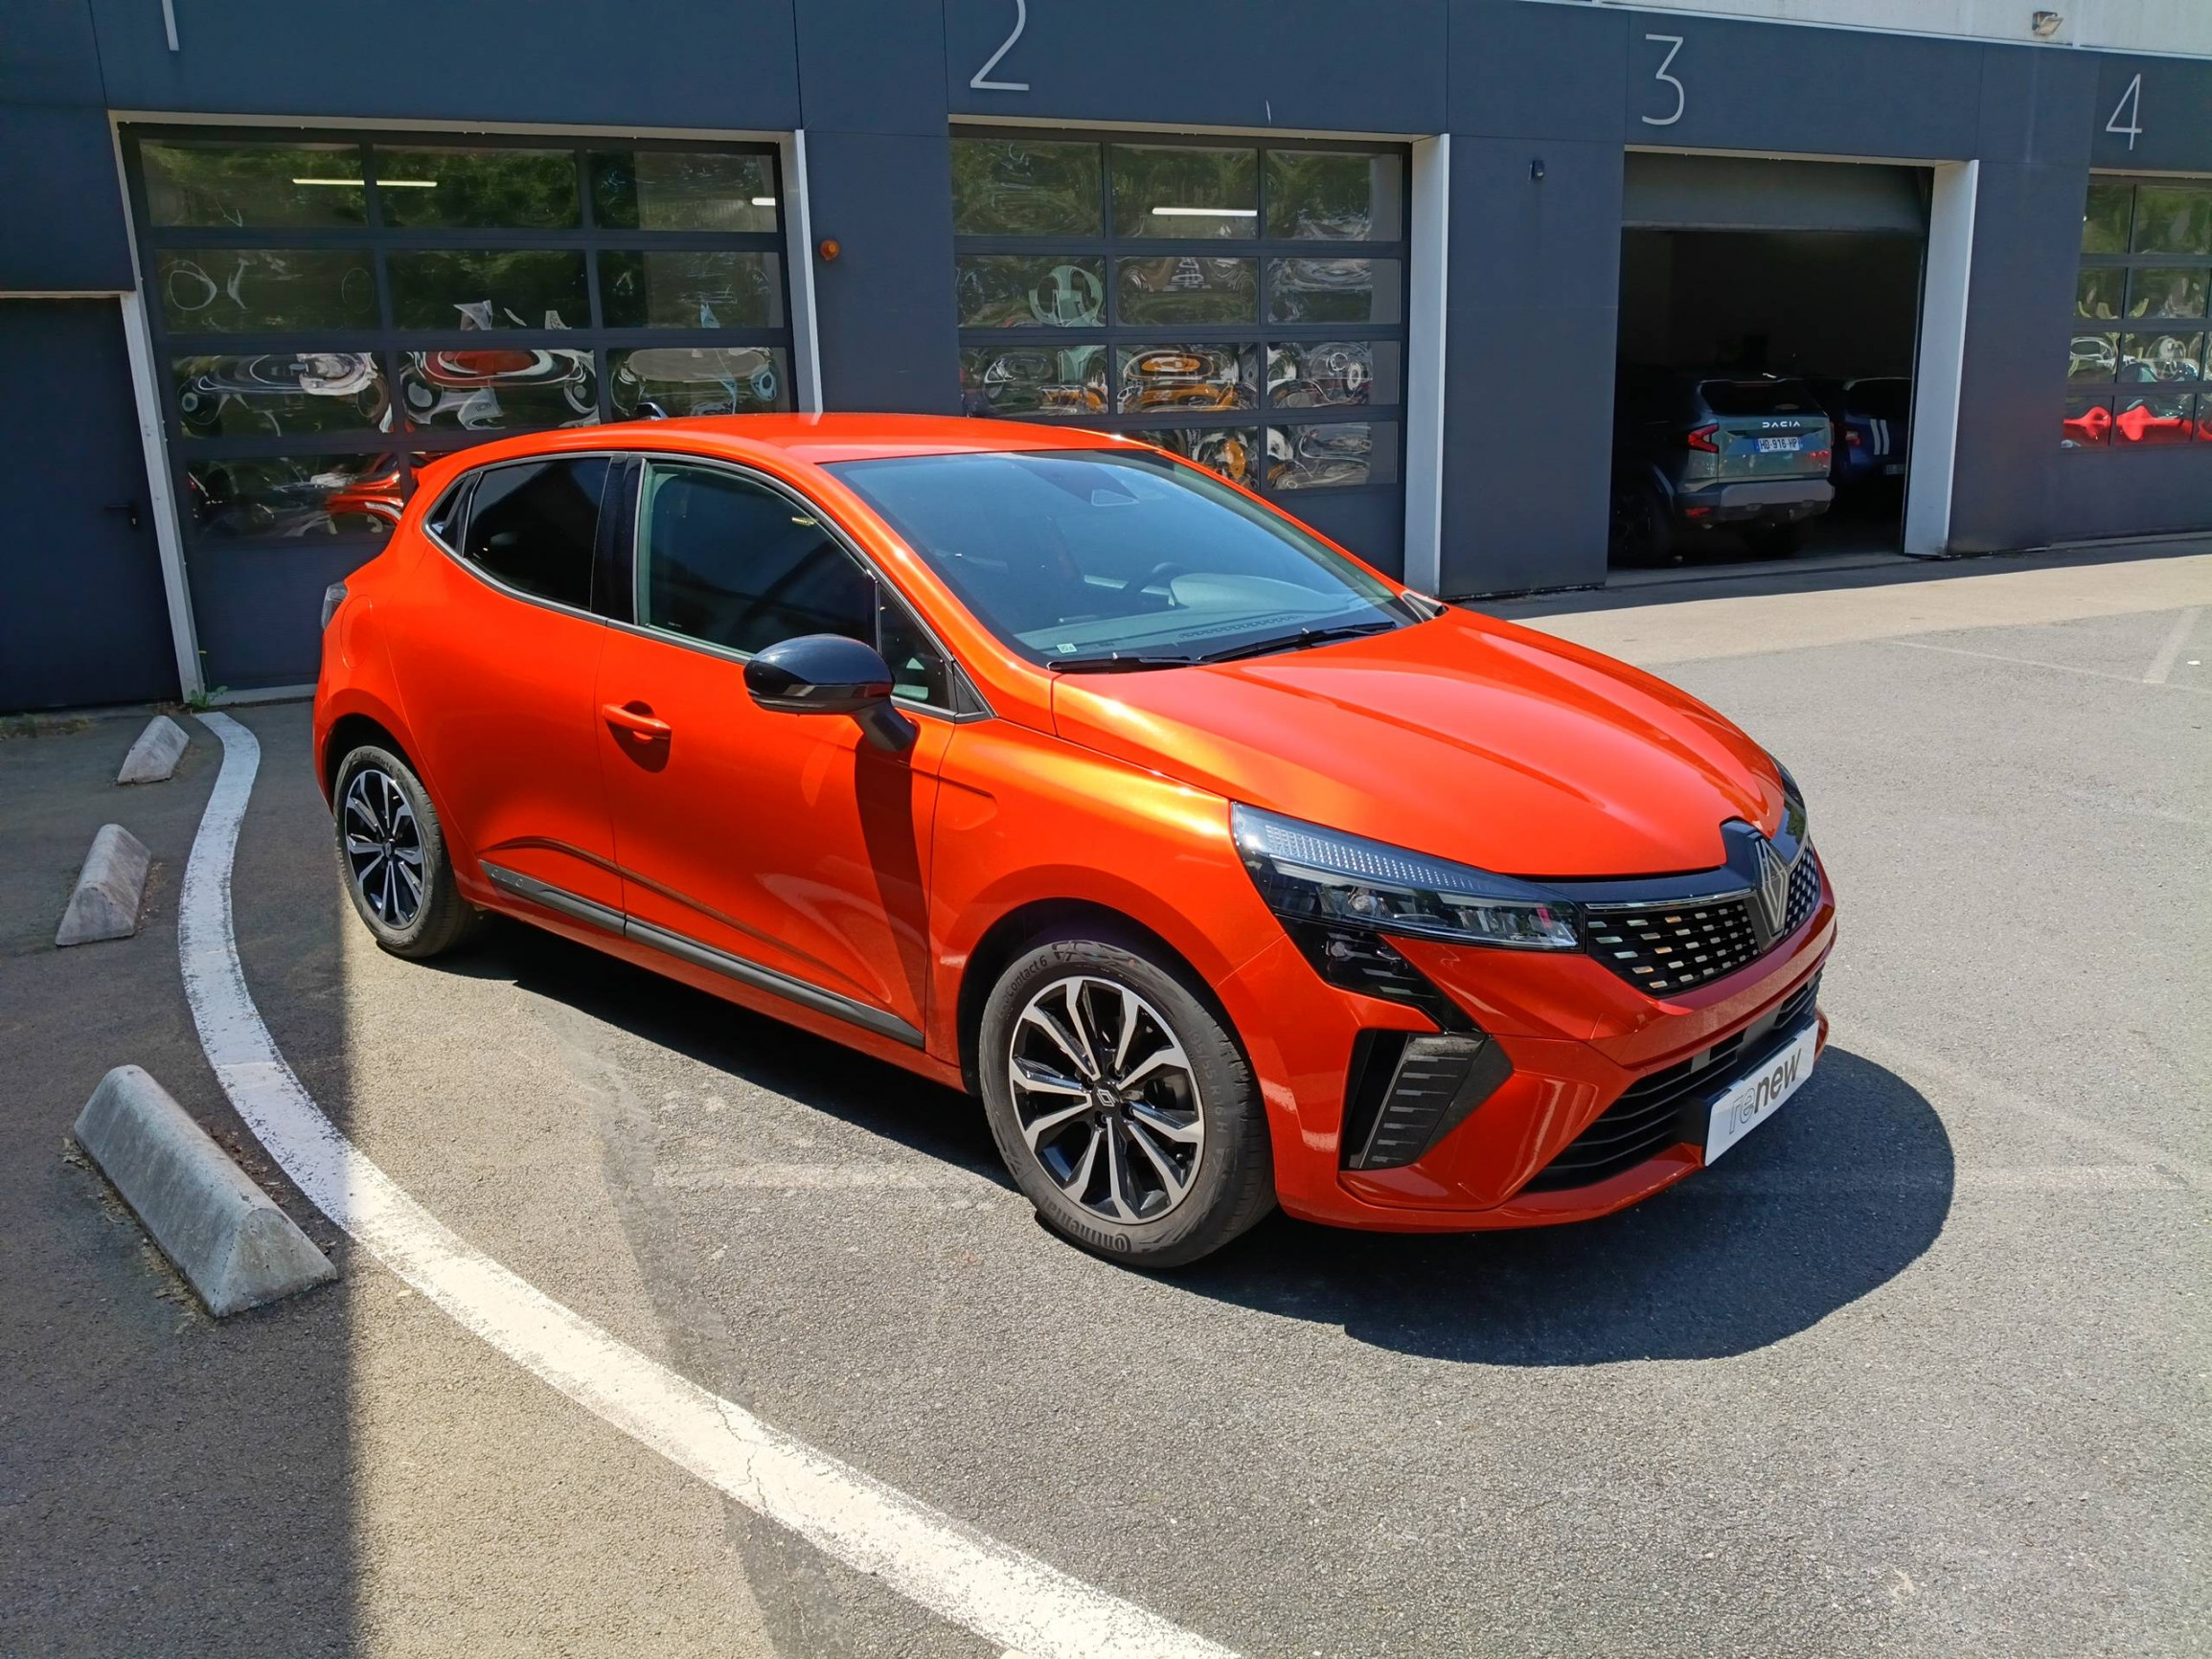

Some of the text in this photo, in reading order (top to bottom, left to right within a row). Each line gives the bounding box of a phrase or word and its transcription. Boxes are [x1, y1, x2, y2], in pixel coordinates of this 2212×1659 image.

[970, 0, 1029, 91] 2
[1642, 34, 1684, 125] 3
[2106, 74, 2142, 150] 4
[1729, 1048, 1801, 1135] renew
